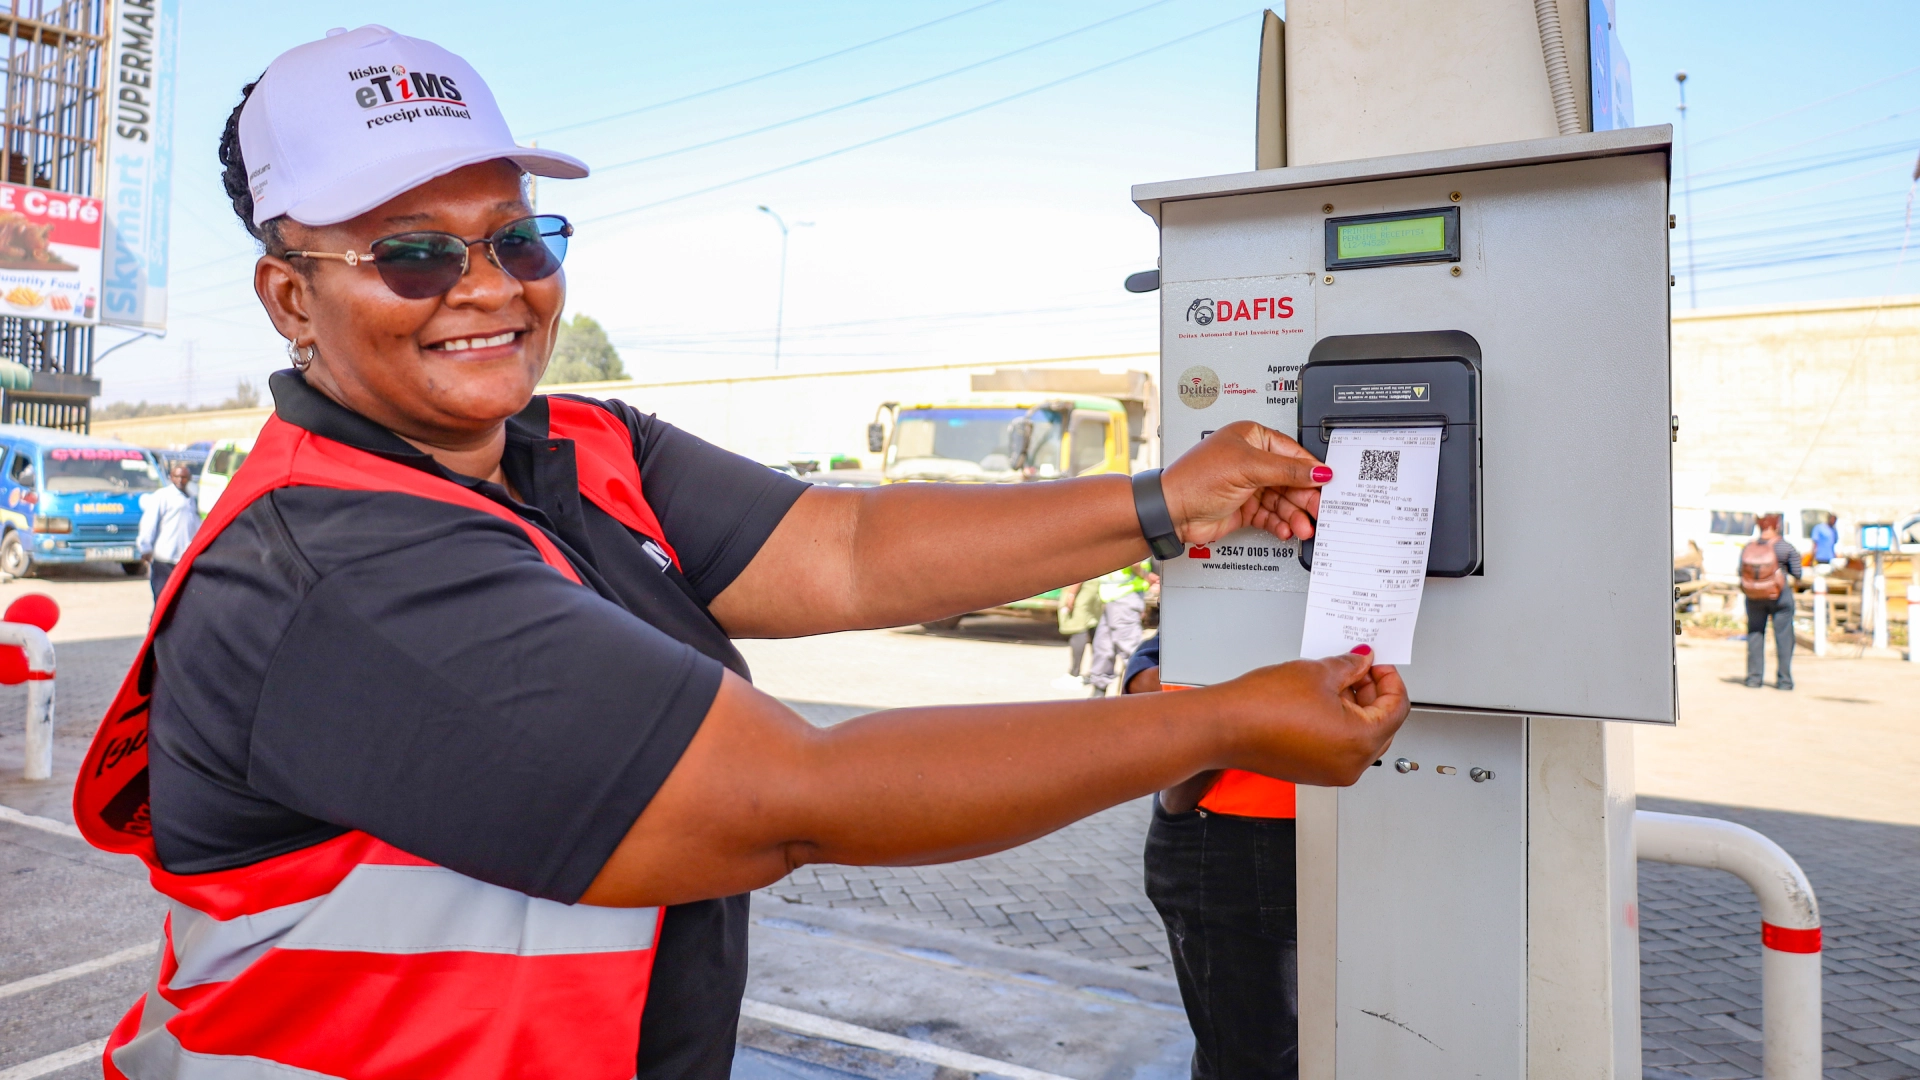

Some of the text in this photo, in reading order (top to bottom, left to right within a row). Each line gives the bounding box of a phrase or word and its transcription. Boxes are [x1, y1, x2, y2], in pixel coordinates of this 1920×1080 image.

[348, 64, 388, 82] Itisha
[356, 66, 462, 109] eTiMS
[366, 104, 472, 129] receipt ukifuel
[0, 186, 99, 224] E Café
[105, 154, 146, 314] Skymart
[1343, 233, 1376, 242] PENDING
[0, 272, 81, 290] uantity Food
[1216, 296, 1294, 322] DAFIS
[1268, 364, 1304, 374] Approved
[1180, 382, 1218, 395] Deities
[1216, 546, 1294, 558] +2547 0105 1689
[1202, 562, 1280, 572] www.deitiestech.com
